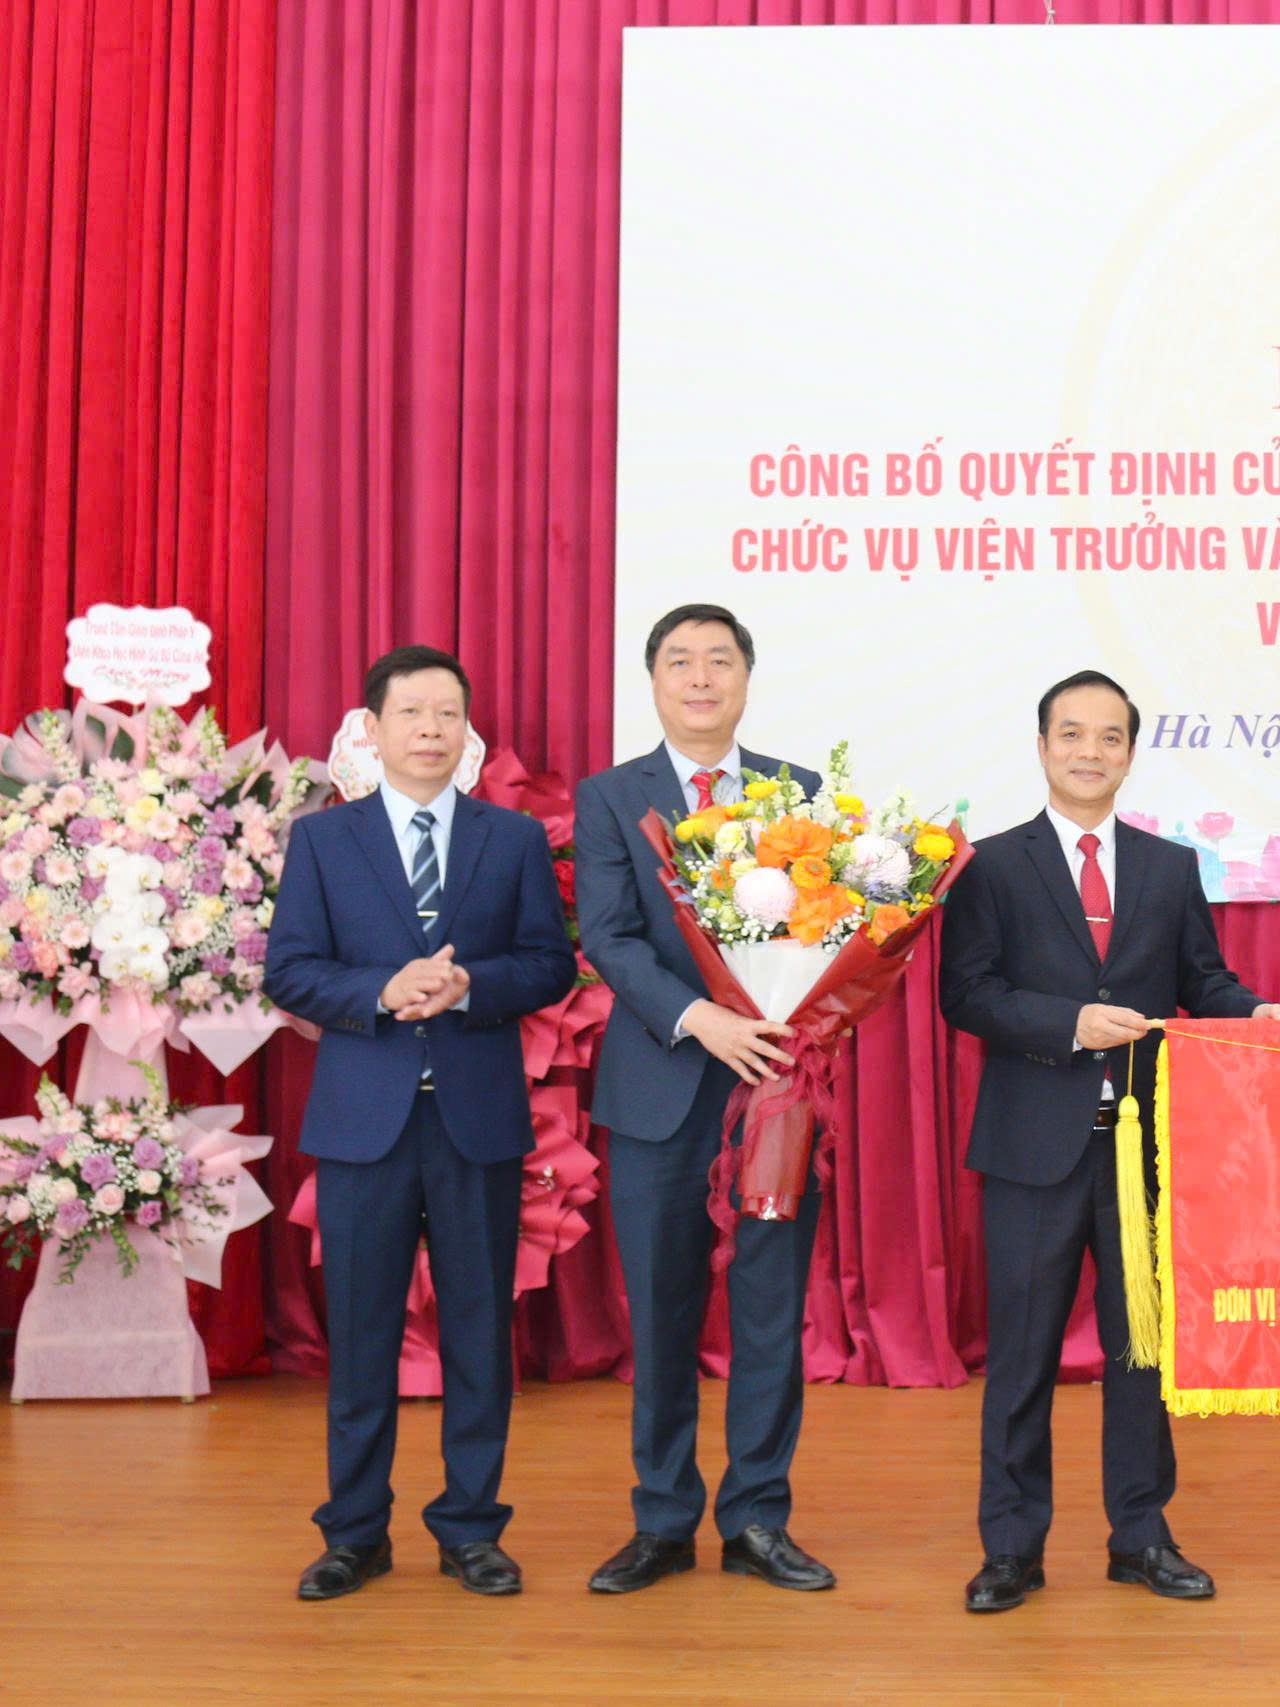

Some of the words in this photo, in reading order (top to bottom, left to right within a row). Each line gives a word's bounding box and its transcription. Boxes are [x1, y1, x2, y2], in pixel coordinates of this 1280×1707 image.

[751, 445, 868, 496] CÔNG
[886, 437, 942, 496] BỐ
[960, 438, 1095, 501] QUYẾT
[1110, 452, 1216, 505] ĐỊNH
[733, 520, 847, 572] CHỨC
[865, 528, 918, 581] VỤ
[936, 518, 1034, 581] VIỆN
[1051, 512, 1225, 571] TRƯỞNG
[1151, 715, 1210, 748] Hà
[1213, 1287, 1252, 1322] ĐƠN
[1256, 1288, 1277, 1327] VỊ
